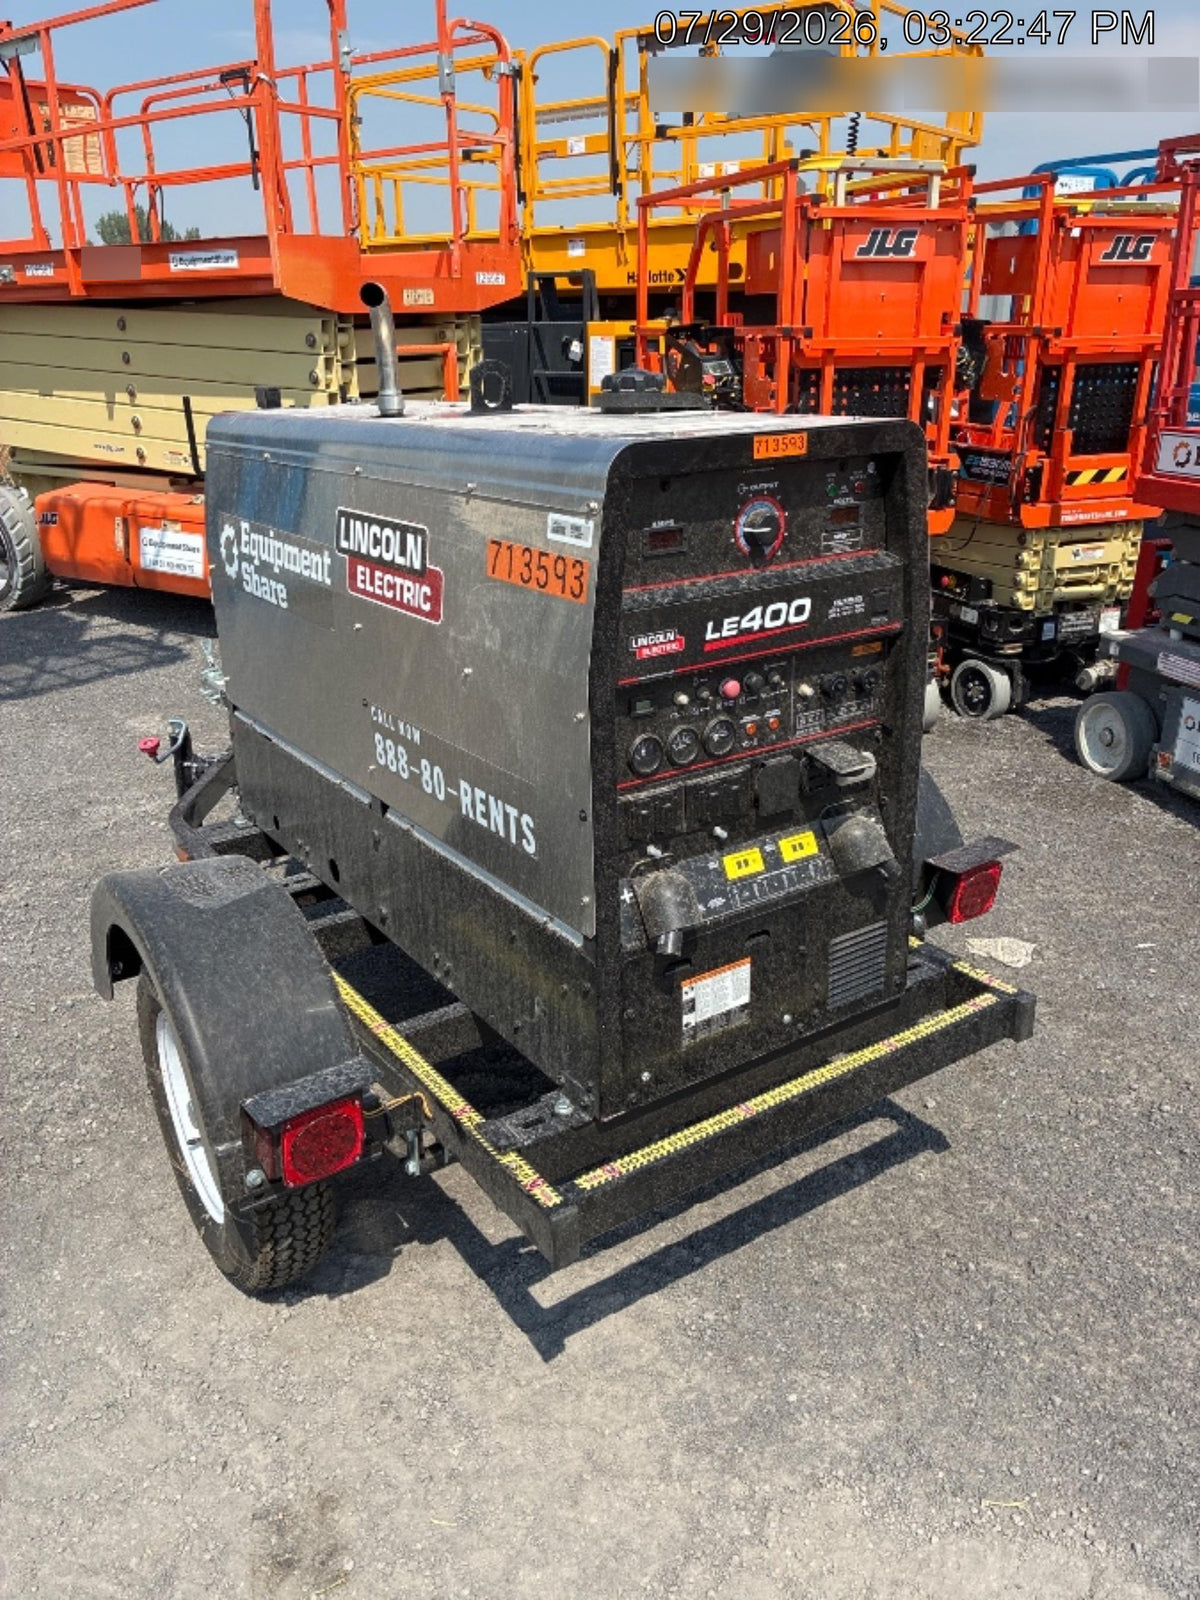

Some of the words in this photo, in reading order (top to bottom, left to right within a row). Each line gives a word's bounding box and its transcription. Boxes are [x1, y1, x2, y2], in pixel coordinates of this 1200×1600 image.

[855, 228, 919, 258] JLG
[1099, 235, 1157, 262] JLG
[627, 270, 674, 284] Hlotte
[756, 435, 804, 454] 713593
[240, 520, 332, 586] Equipment
[340, 516, 423, 570] LINCOLN
[240, 561, 289, 609] Share
[356, 564, 432, 612] ELECTRIC
[490, 540, 584, 599] 713593
[632, 631, 675, 648] LINCOLN
[705, 597, 812, 641] LE400
[370, 705, 395, 731] CALL
[398, 719, 421, 745] NOW
[374, 731, 536, 855] 888-80-RENTS
